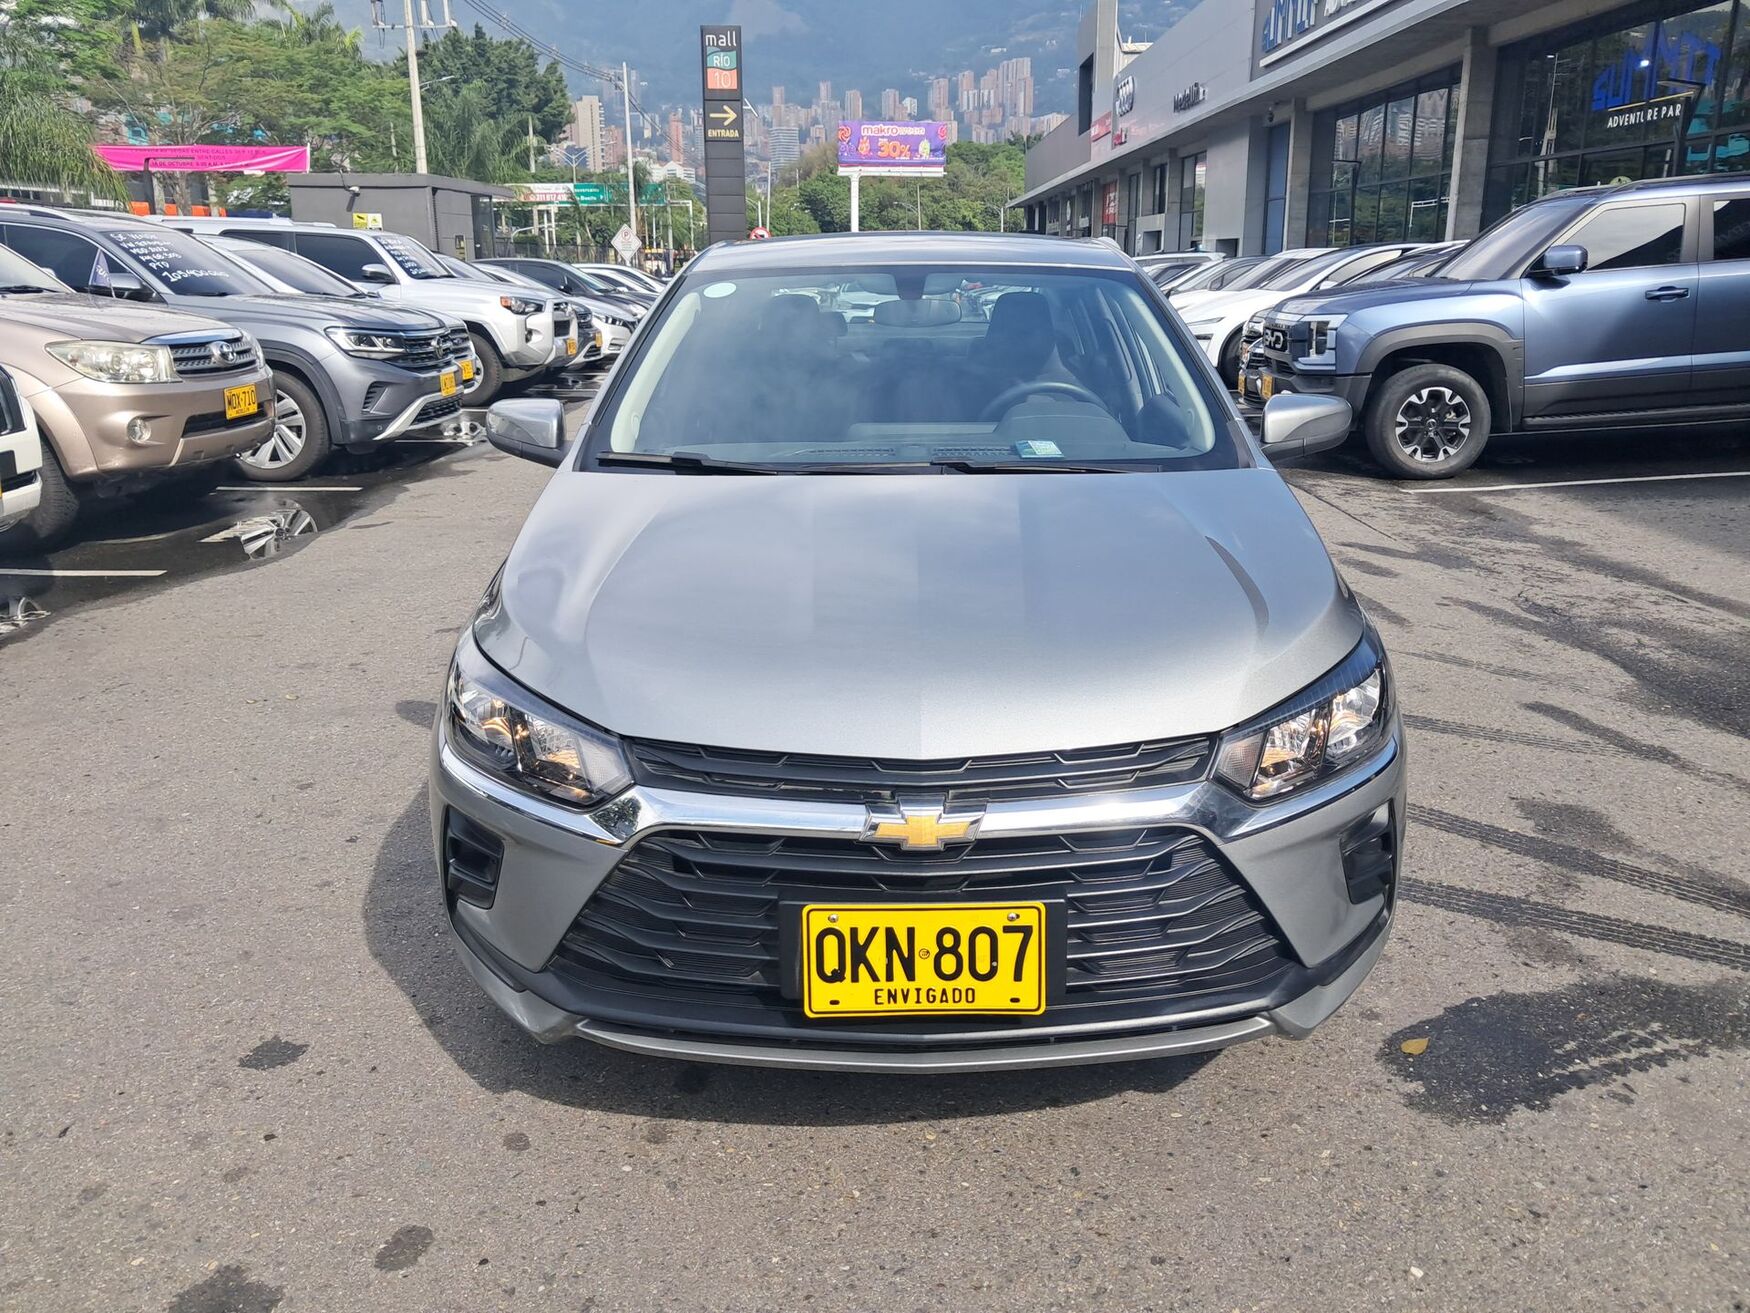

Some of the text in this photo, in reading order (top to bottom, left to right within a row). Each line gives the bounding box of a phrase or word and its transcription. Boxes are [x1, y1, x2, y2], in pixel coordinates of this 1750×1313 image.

[705, 30, 737, 47] mall
[714, 72, 731, 88] 10
[1661, 103, 1683, 119] PAR
[708, 129, 739, 138] ENTRADA
[877, 140, 911, 157] 30%
[1264, 328, 1284, 349] BYD
[815, 924, 1034, 983] QKN 807
[874, 987, 976, 1006] ENVIGADO
